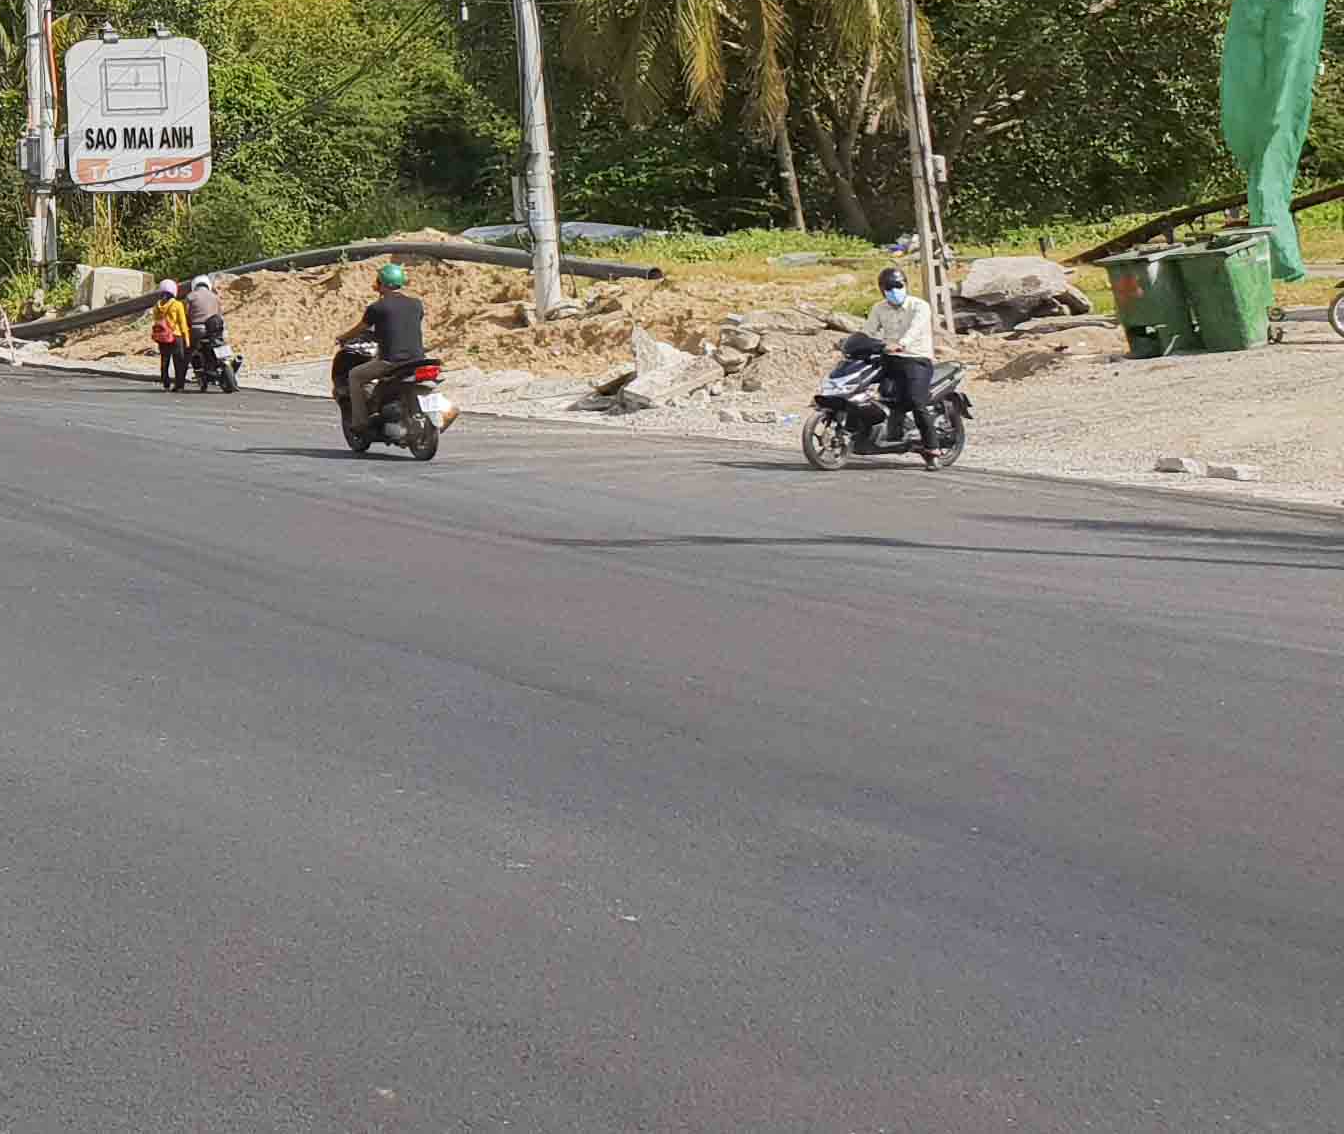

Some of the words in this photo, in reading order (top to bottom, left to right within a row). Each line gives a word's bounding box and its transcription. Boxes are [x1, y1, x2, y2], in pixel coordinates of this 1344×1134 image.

[85, 127, 117, 150] SAO
[123, 127, 154, 150] MAI
[160, 126, 194, 148] ANH
